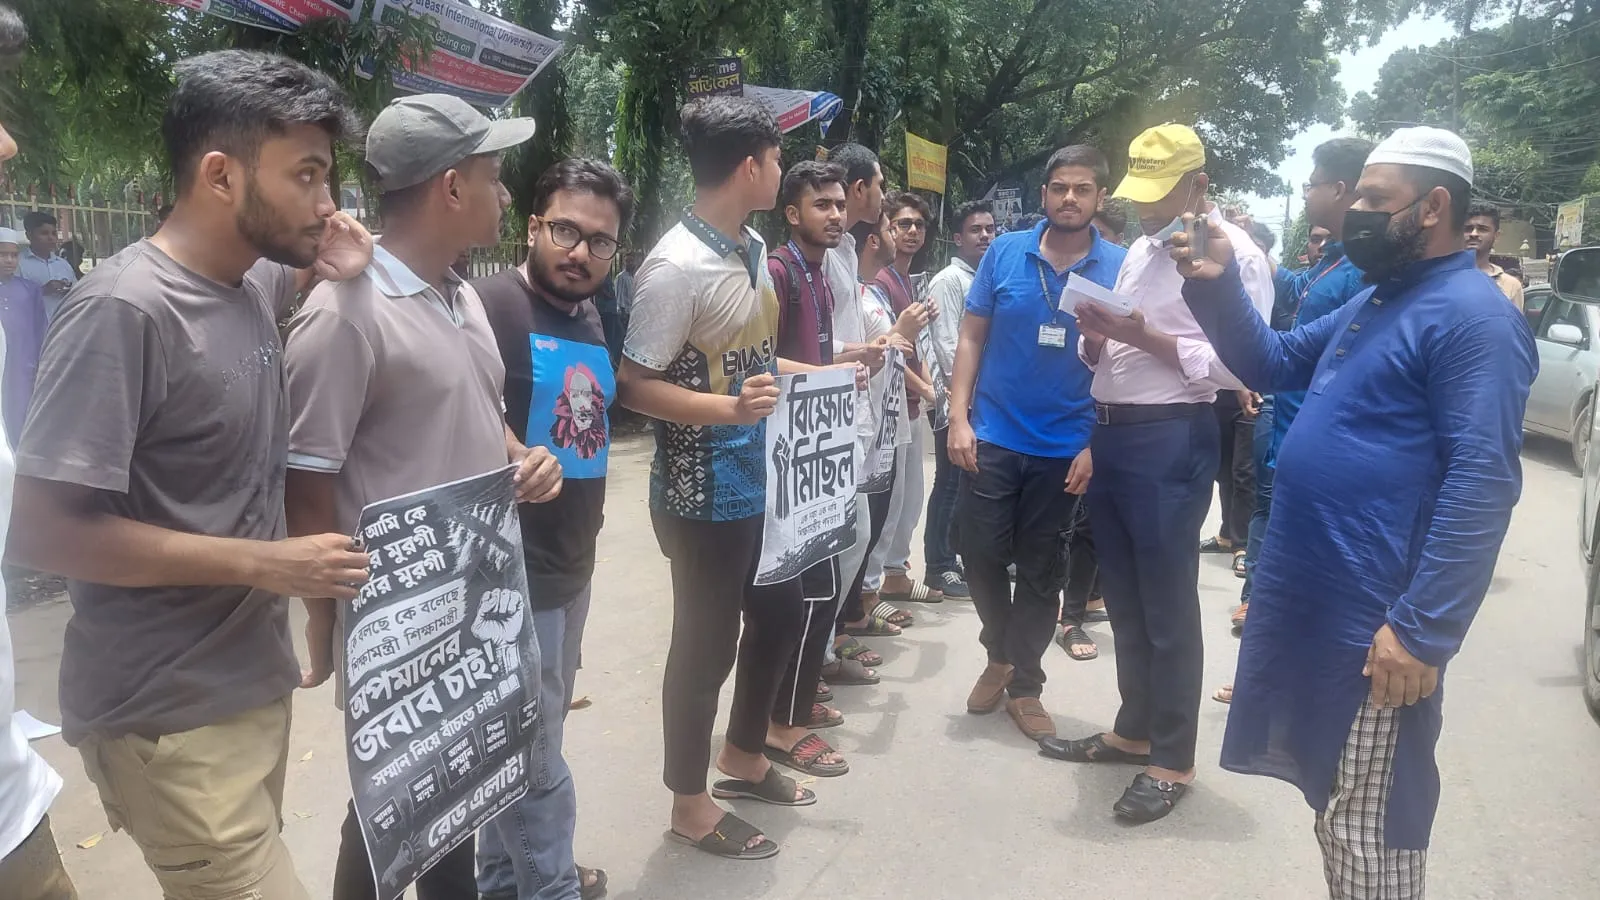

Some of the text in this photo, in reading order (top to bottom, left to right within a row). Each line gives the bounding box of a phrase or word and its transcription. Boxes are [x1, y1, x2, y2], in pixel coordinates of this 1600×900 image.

[434, 30, 471, 53] Going on
[445, 5, 497, 39] International
[497, 28, 533, 53] University
[786, 373, 854, 441] বিক্ষোভ
[791, 431, 855, 507] মিছিল
[364, 513, 400, 539] আমি
[404, 505, 427, 525] কে
[383, 525, 437, 564] মুরগী
[392, 549, 446, 588] মুরগী
[395, 606, 417, 625] কে
[419, 587, 460, 613] বলেছে
[403, 606, 459, 647] শিক্ষামন্ত্রী
[349, 630, 461, 720] অপমানের
[351, 680, 443, 761] জবাব
[438, 639, 499, 700] চাই!
[371, 689, 500, 787] সম্মান নিয়ে বাঁচতে চাই!
[428, 800, 467, 848] রেড
